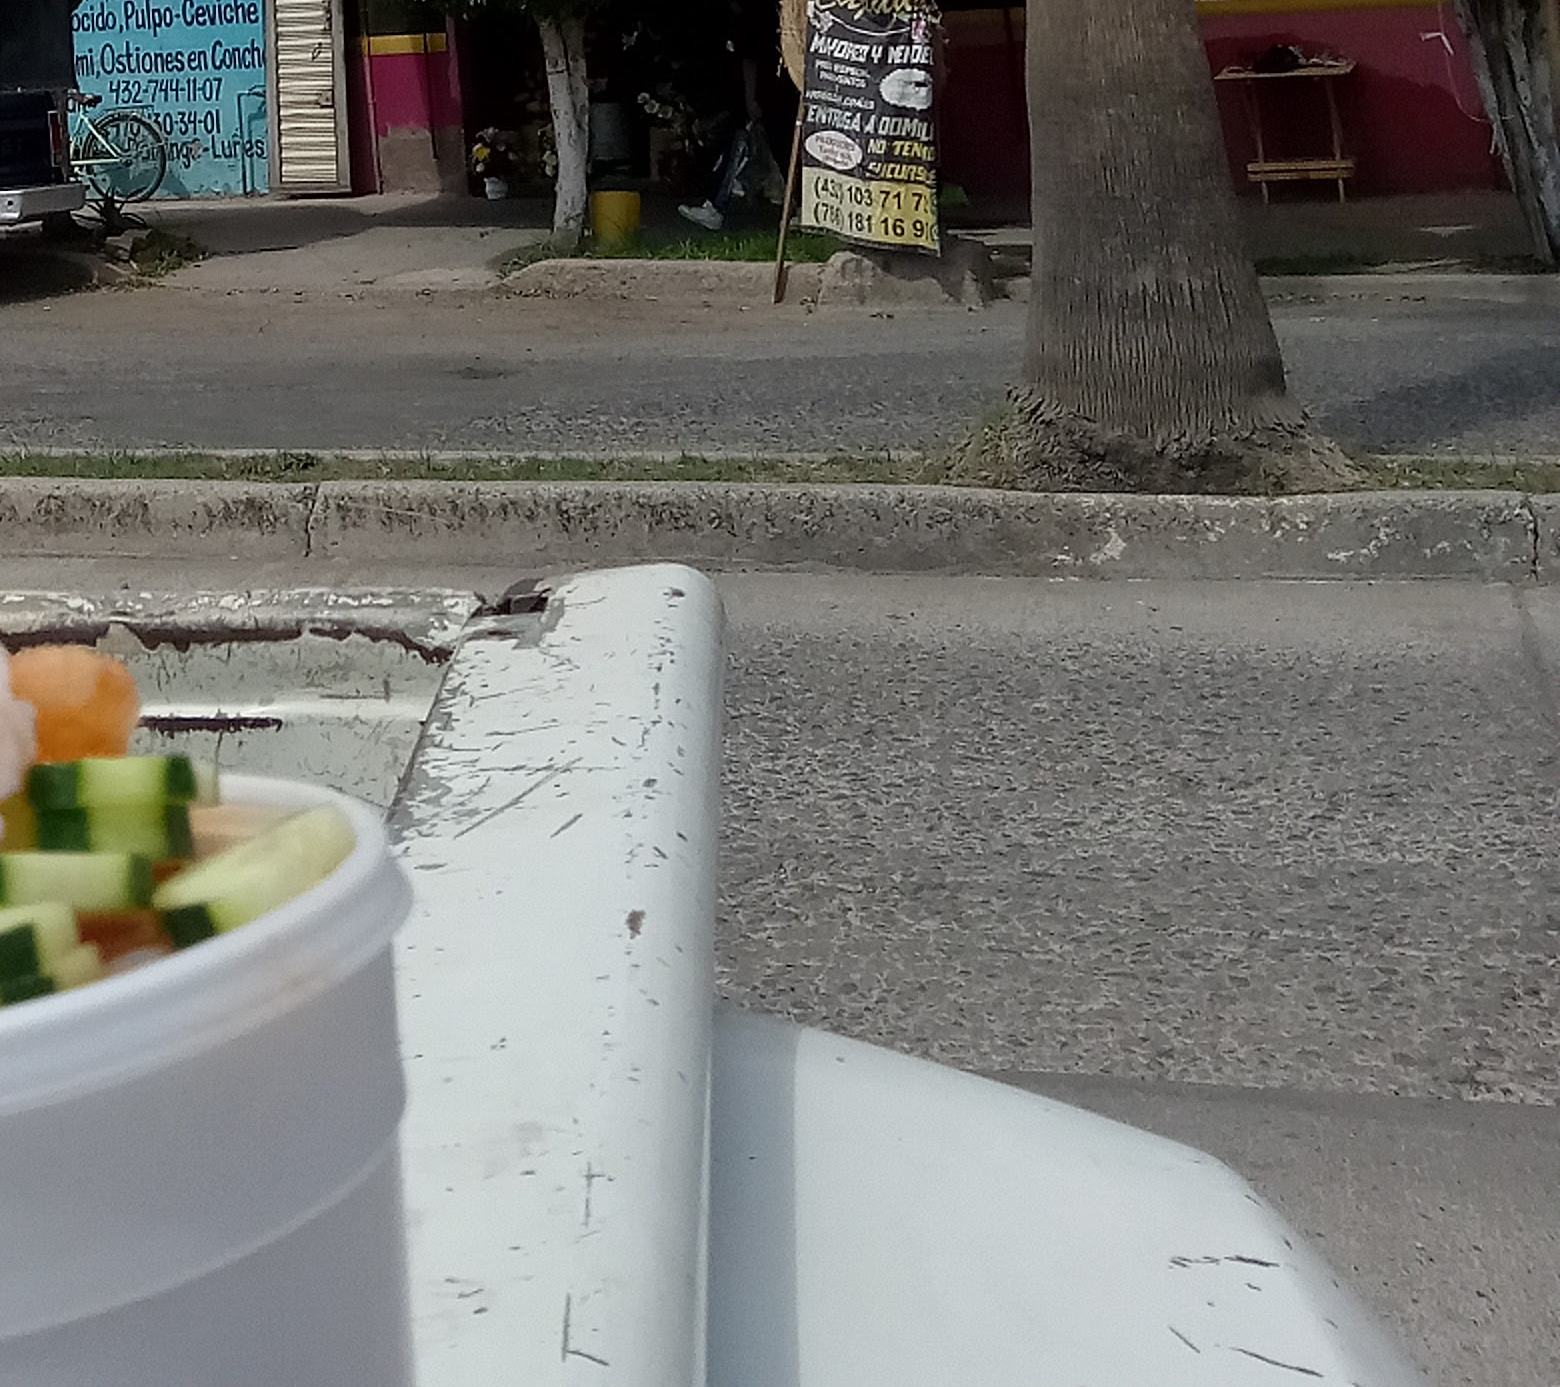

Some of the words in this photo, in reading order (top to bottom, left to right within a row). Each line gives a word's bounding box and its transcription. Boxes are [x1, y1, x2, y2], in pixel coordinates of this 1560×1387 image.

[101, 40, 185, 75] Ostiones
[187, 51, 208, 71] en
[211, 38, 265, 71] Conch
[109, 78, 223, 104] 432-744-11-07
[847, 185, 873, 207] 103
[880, 190, 902, 210] 71
[847, 211, 873, 234] 181
[881, 217, 905, 237] 16
